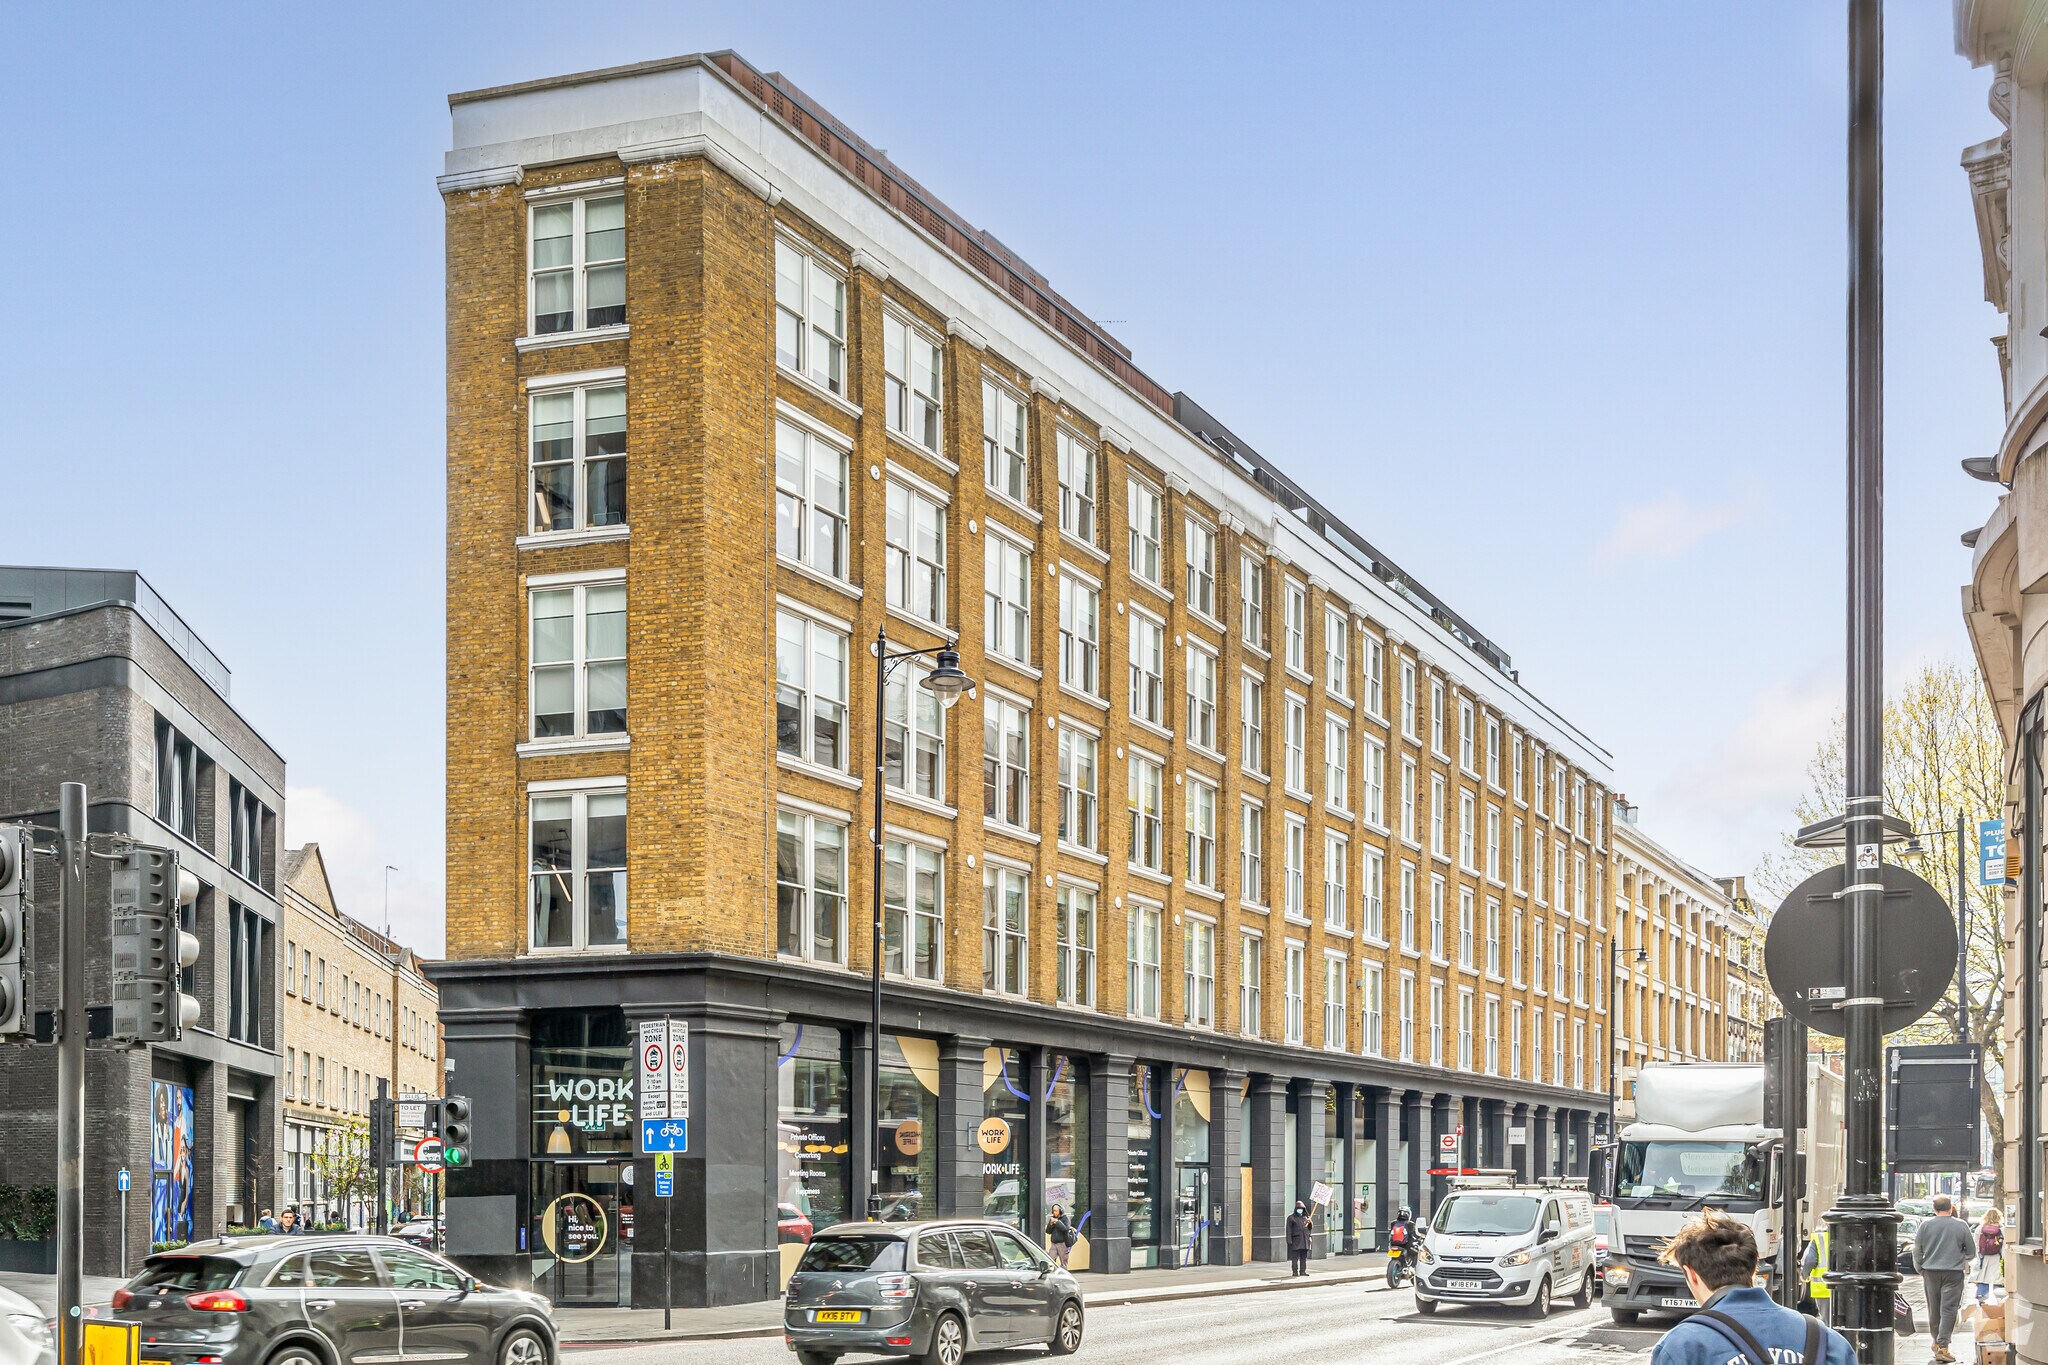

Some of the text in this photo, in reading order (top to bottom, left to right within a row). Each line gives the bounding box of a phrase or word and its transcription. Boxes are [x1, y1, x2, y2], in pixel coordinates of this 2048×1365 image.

[644, 1034, 662, 1043] ZONE
[673, 1034, 685, 1043] ZONE
[549, 1078, 633, 1102] WORK
[572, 1104, 626, 1127] LIFE
[808, 1133, 826, 1141] Offices
[794, 1152, 821, 1160] Coworking
[789, 1169, 826, 1178] Meeting Rooms
[1004, 1163, 1020, 1175] LIFE
[795, 1188, 820, 1196] Happiness
[568, 1215, 578, 1224] Hi,
[583, 1233, 599, 1241] you.
